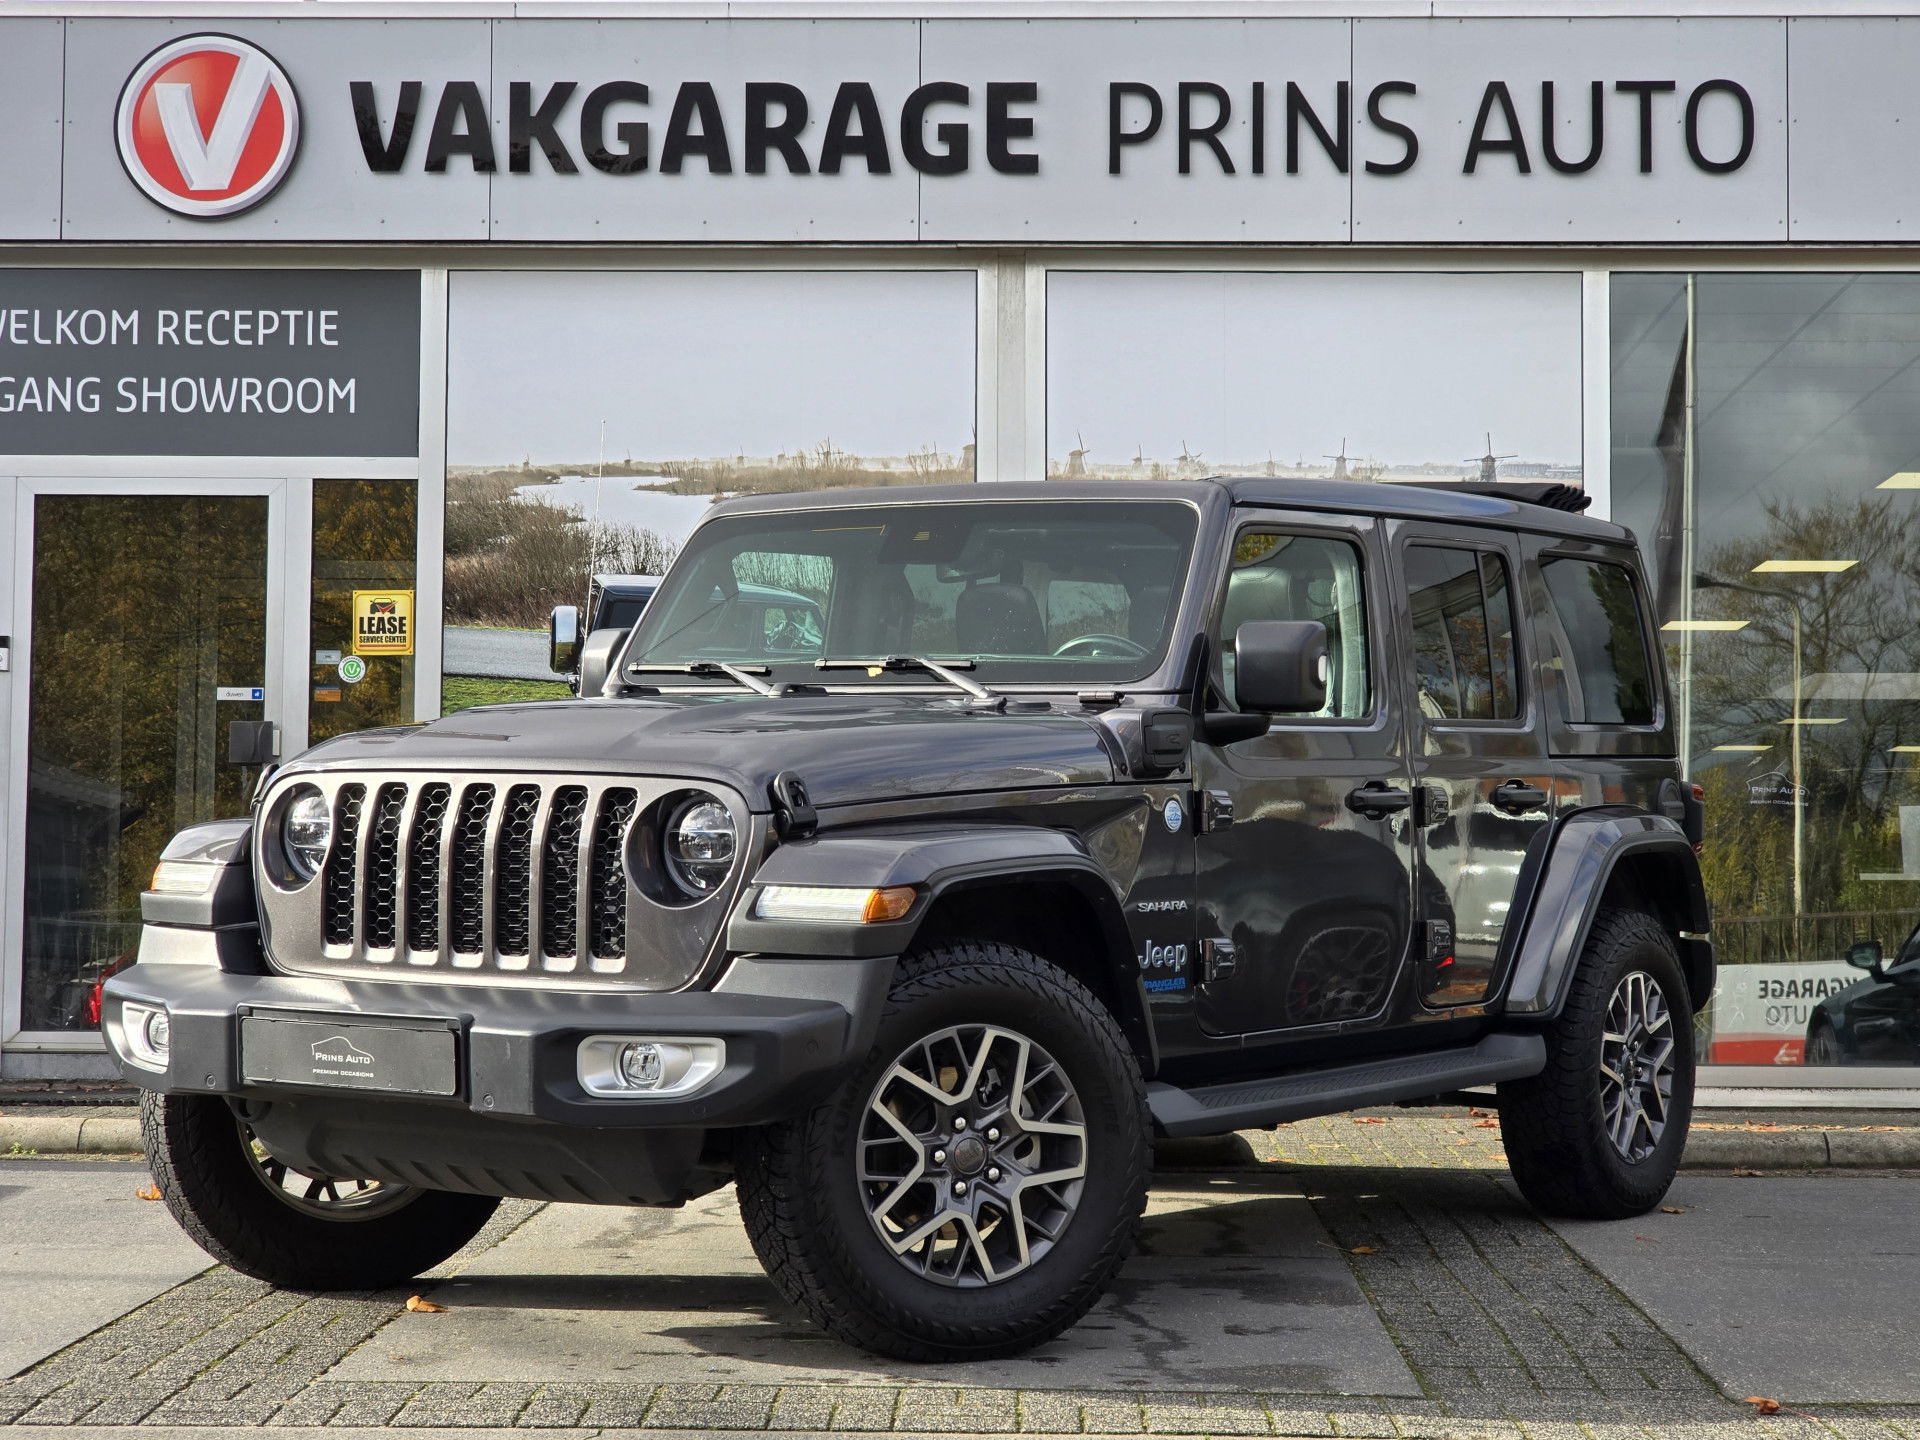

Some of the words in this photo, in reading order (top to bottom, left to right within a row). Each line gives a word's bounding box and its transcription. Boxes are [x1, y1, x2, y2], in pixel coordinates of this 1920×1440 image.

[350, 81, 1039, 175] VAKGARAGE
[1109, 81, 1419, 176] PRINS
[1463, 79, 1755, 175] AUTO
[157, 310, 339, 346] RECEPTIE
[116, 377, 356, 413] SHOWROOM
[359, 616, 407, 635] LEASE
[359, 635, 384, 644] SERVICE
[385, 635, 407, 643] CENTER
[1138, 900, 1188, 912] SAHARA
[1137, 939, 1188, 972] Jeep
[315, 1052, 344, 1062] PRINS
[345, 1054, 371, 1064] AUTO
[340, 1070, 374, 1078] OCCASIONS
